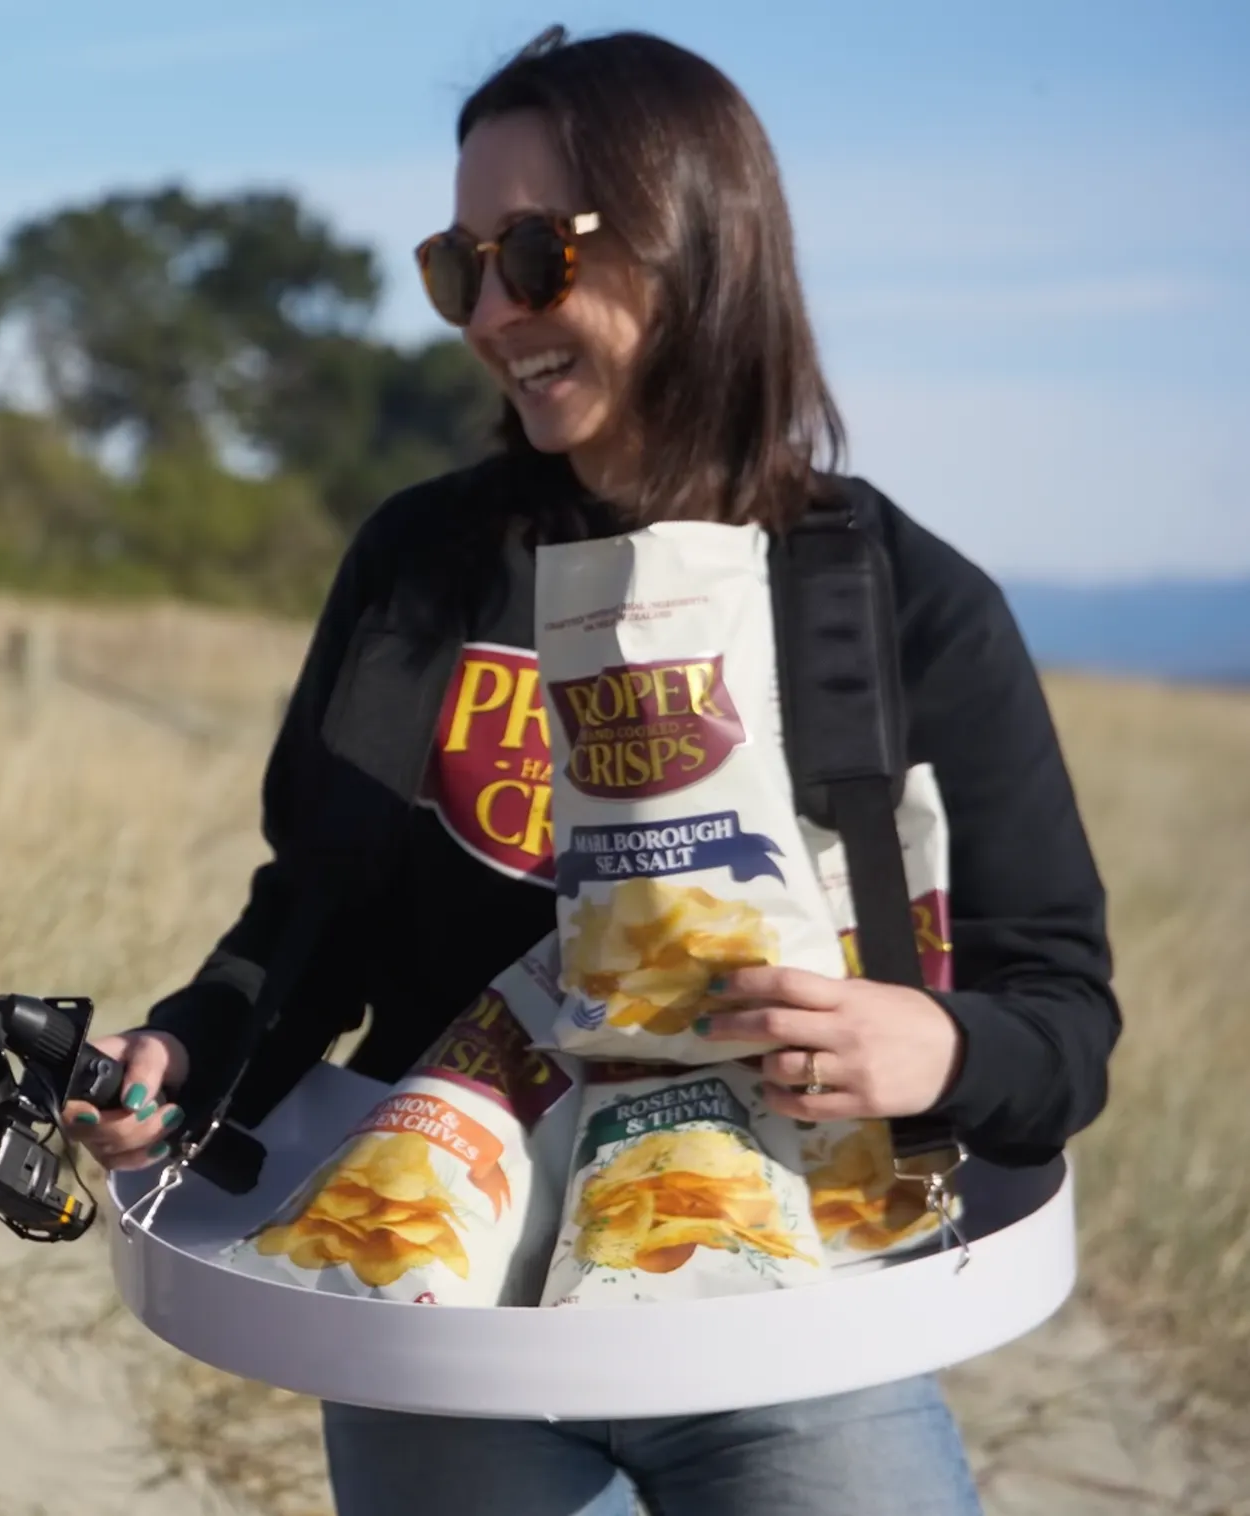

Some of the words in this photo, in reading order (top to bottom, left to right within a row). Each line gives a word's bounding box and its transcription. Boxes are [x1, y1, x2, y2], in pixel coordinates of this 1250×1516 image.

[570, 734, 707, 788] CRISPS
[574, 818, 733, 853] MARLBOROUGH
[595, 853, 632, 874] SEA
[636, 847, 696, 872] SALT
[440, 1110, 462, 1131] &
[625, 1117, 647, 1135] &
[402, 1114, 481, 1161] CHIVES
